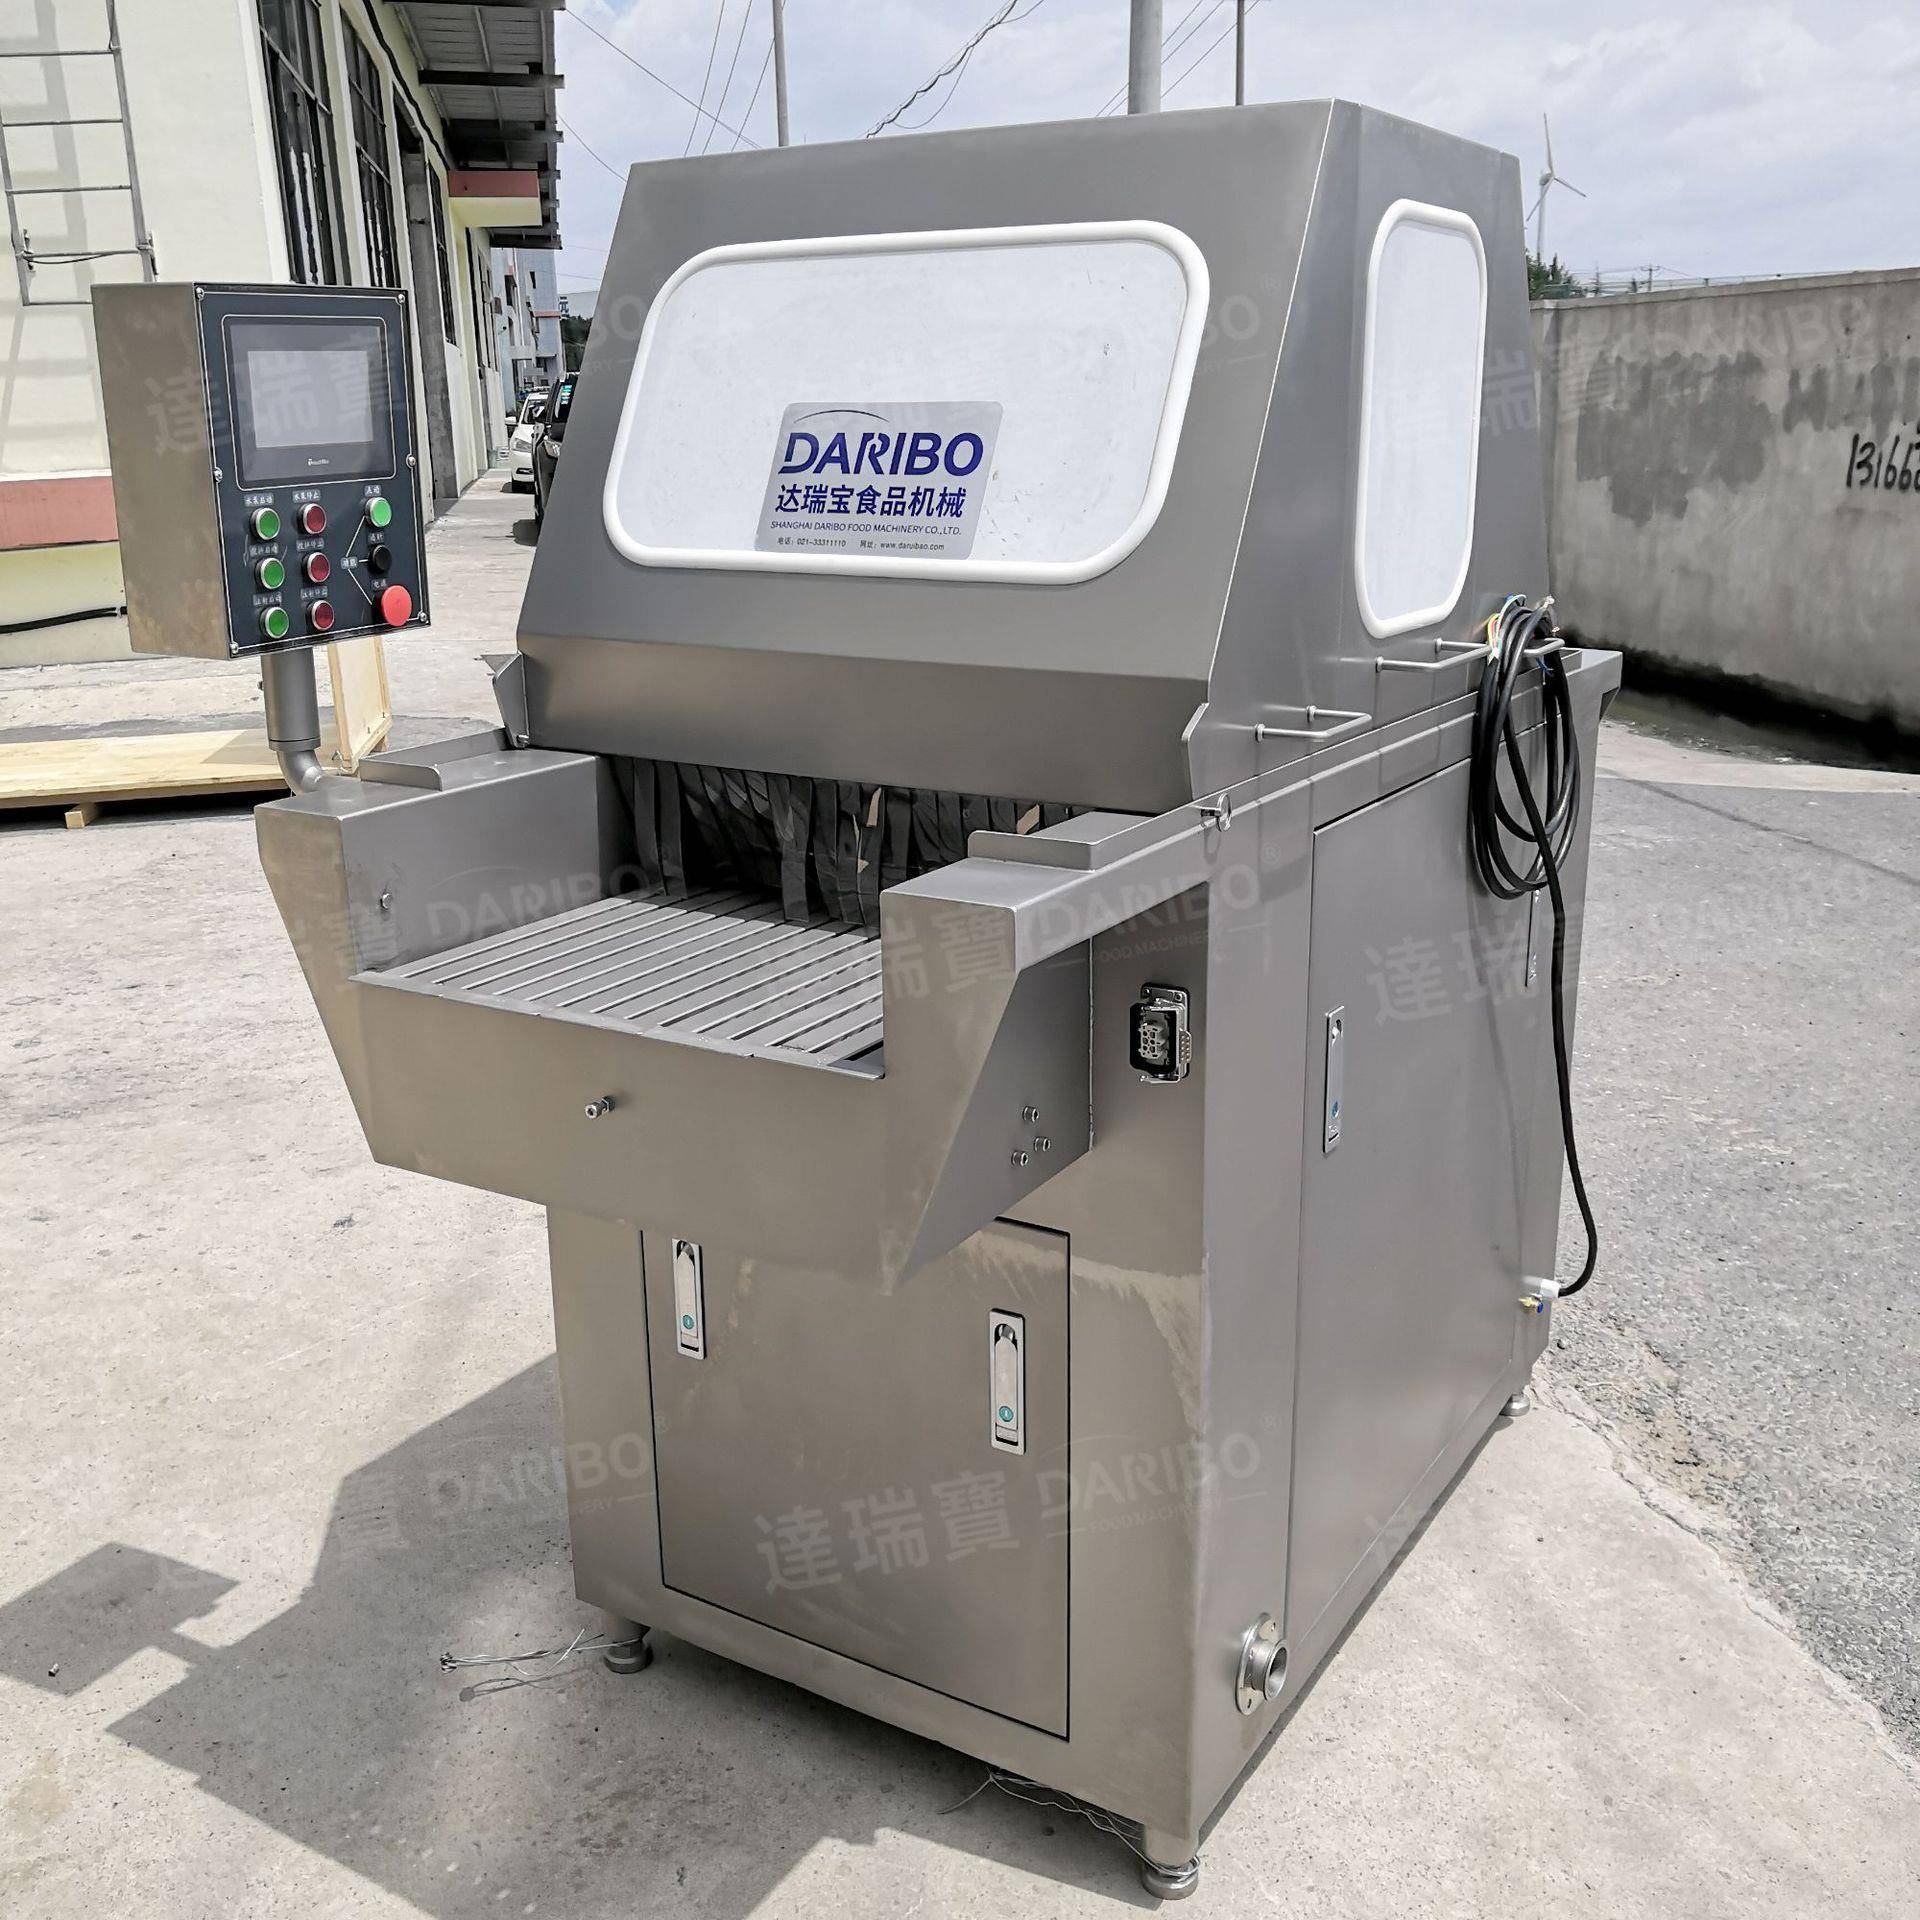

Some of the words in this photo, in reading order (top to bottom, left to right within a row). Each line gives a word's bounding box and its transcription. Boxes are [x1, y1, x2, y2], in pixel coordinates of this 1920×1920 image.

[778, 432, 983, 476] DARIBO
[775, 484, 967, 518] 达瑞宝食品机械
[770, 521, 813, 531] SHANGHAI
[814, 522, 847, 532] DARIBO
[847, 523, 872, 532] FOOD
[873, 523, 924, 534] MACHINERY
